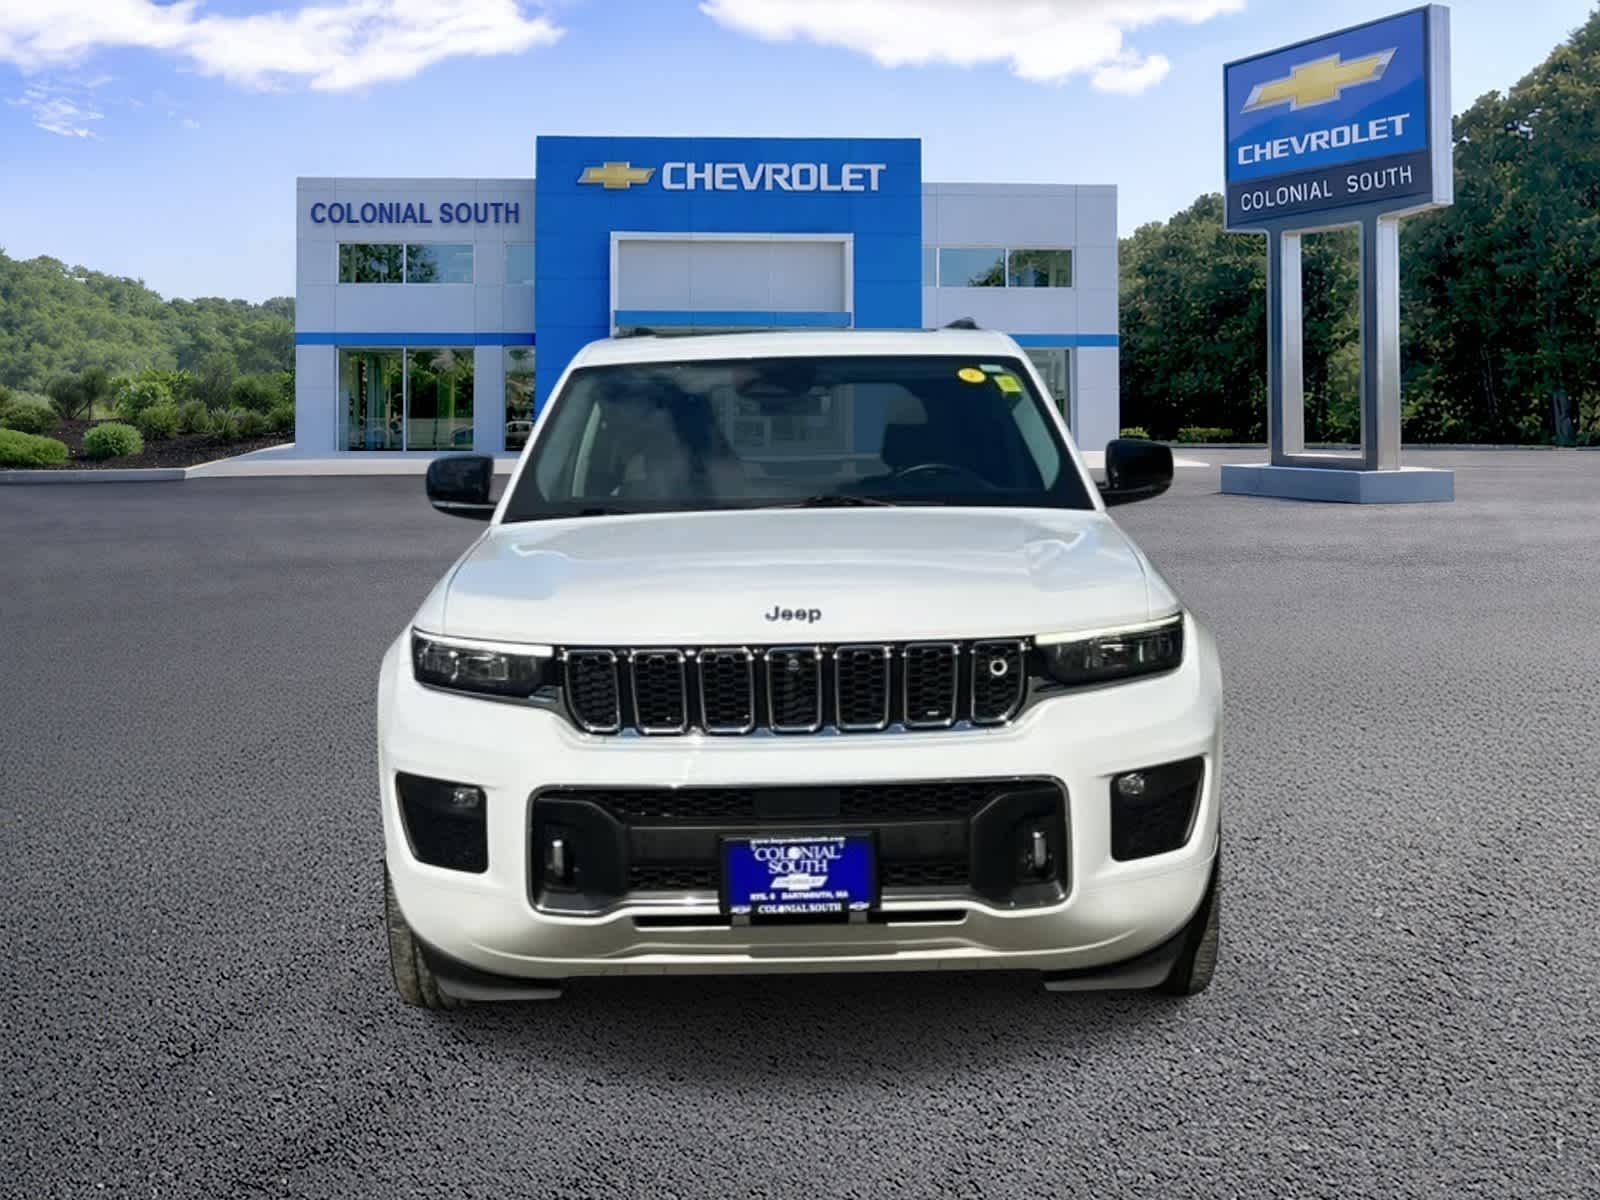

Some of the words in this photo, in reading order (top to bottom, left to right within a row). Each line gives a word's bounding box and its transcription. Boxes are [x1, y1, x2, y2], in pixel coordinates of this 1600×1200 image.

[1237, 113, 1410, 166] CHEVROLET
[661, 161, 887, 191] CHEVROLET
[1240, 180, 1333, 211] COLONIAL
[1346, 165, 1413, 194] SOUTH
[310, 202, 432, 224] COLONIAL
[439, 202, 520, 224] SOUTH
[764, 605, 822, 624] Jeep
[754, 845, 842, 861] COLONIAL
[768, 859, 828, 874] SOUTH
